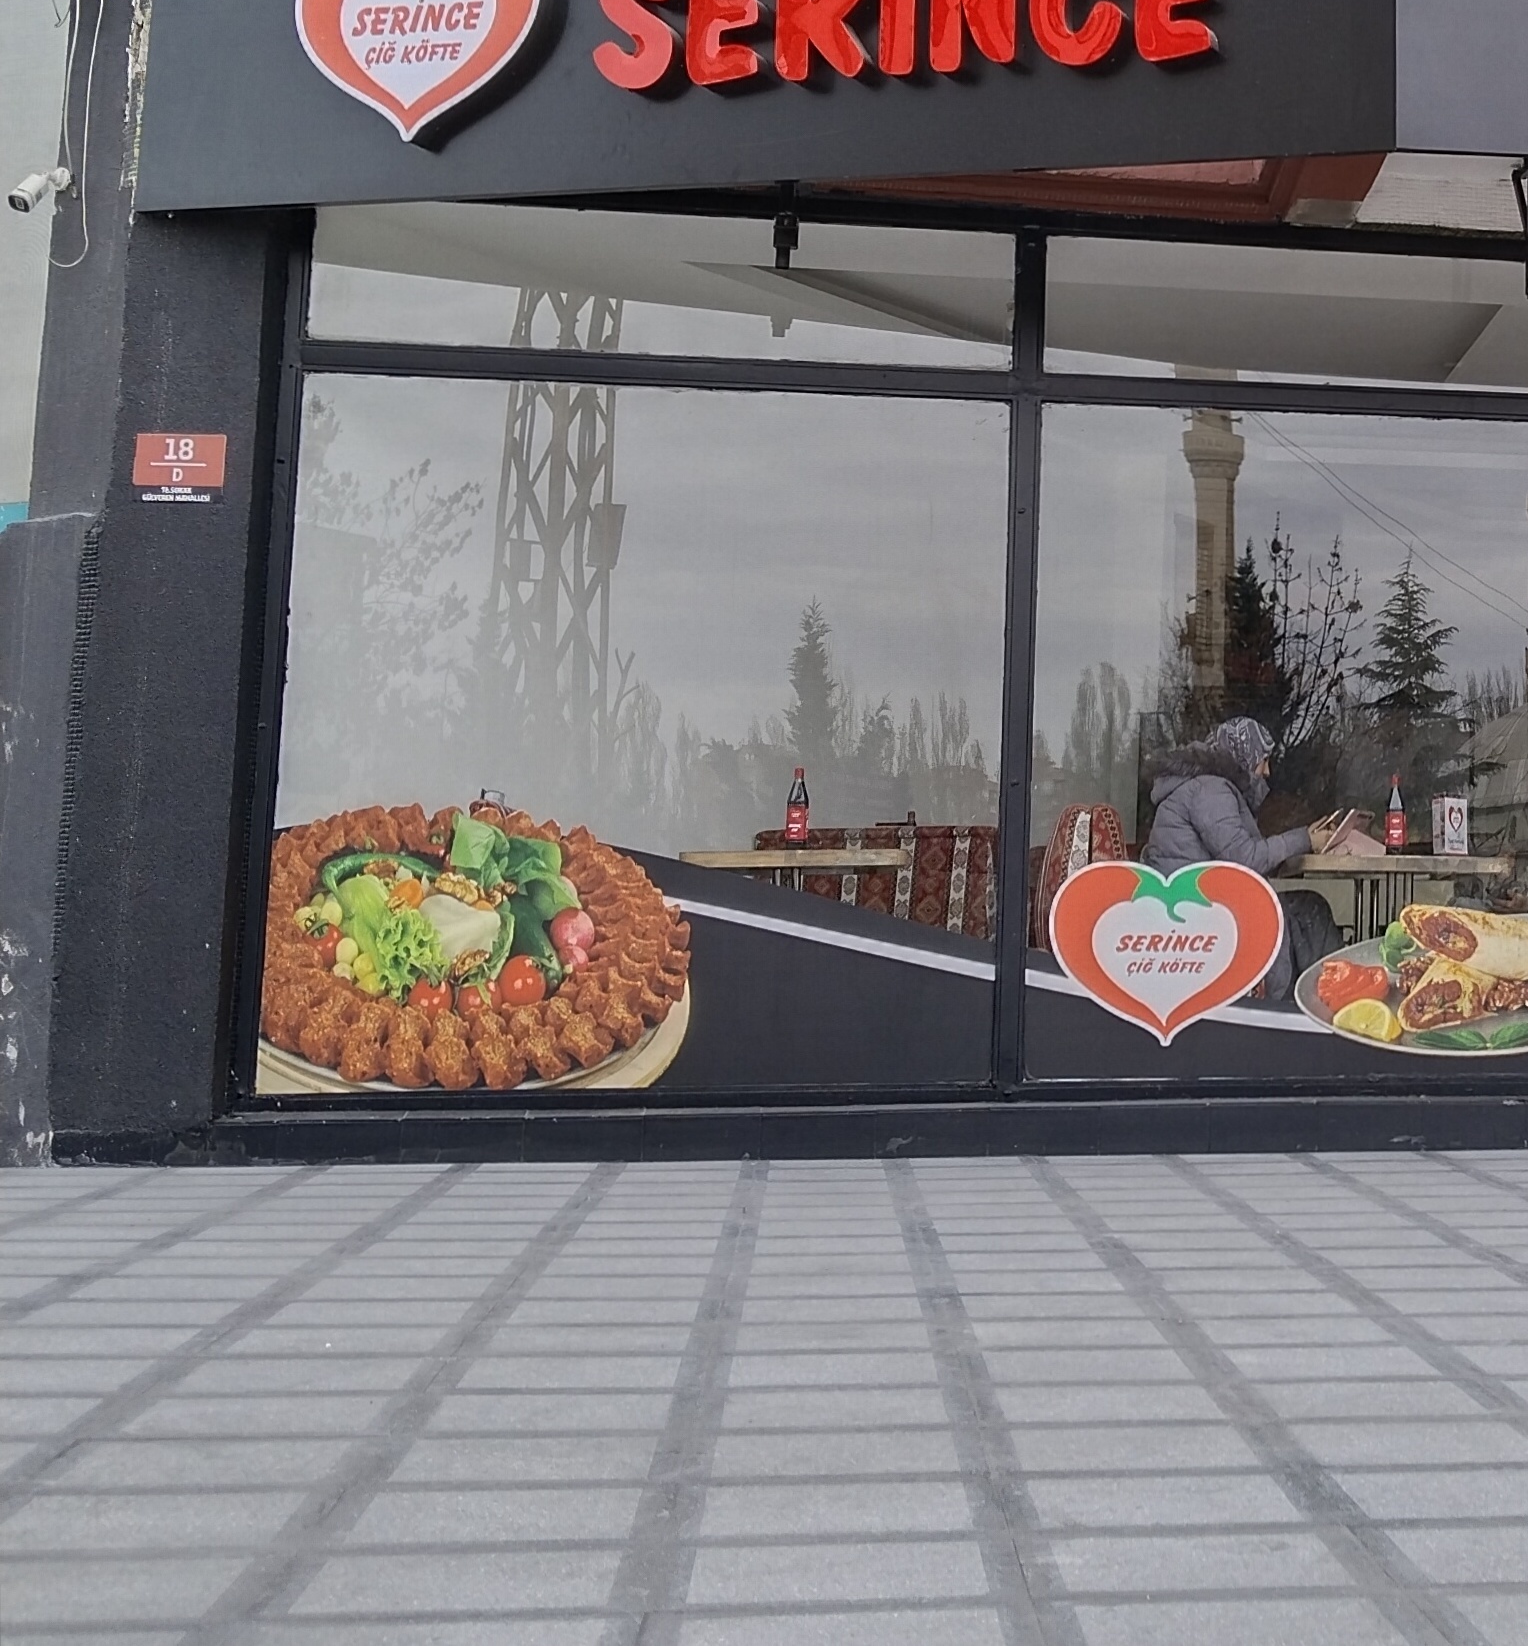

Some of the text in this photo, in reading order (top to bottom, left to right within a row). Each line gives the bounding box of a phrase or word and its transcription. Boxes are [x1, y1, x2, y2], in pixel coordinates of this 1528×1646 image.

[364, 38, 463, 70] ÇİĞ KÖFTE
[163, 438, 194, 460] 18
[172, 467, 183, 482] D
[1115, 929, 1219, 953] SERİNCE
[1126, 958, 1206, 977] ÇİĞ KÖFTE
